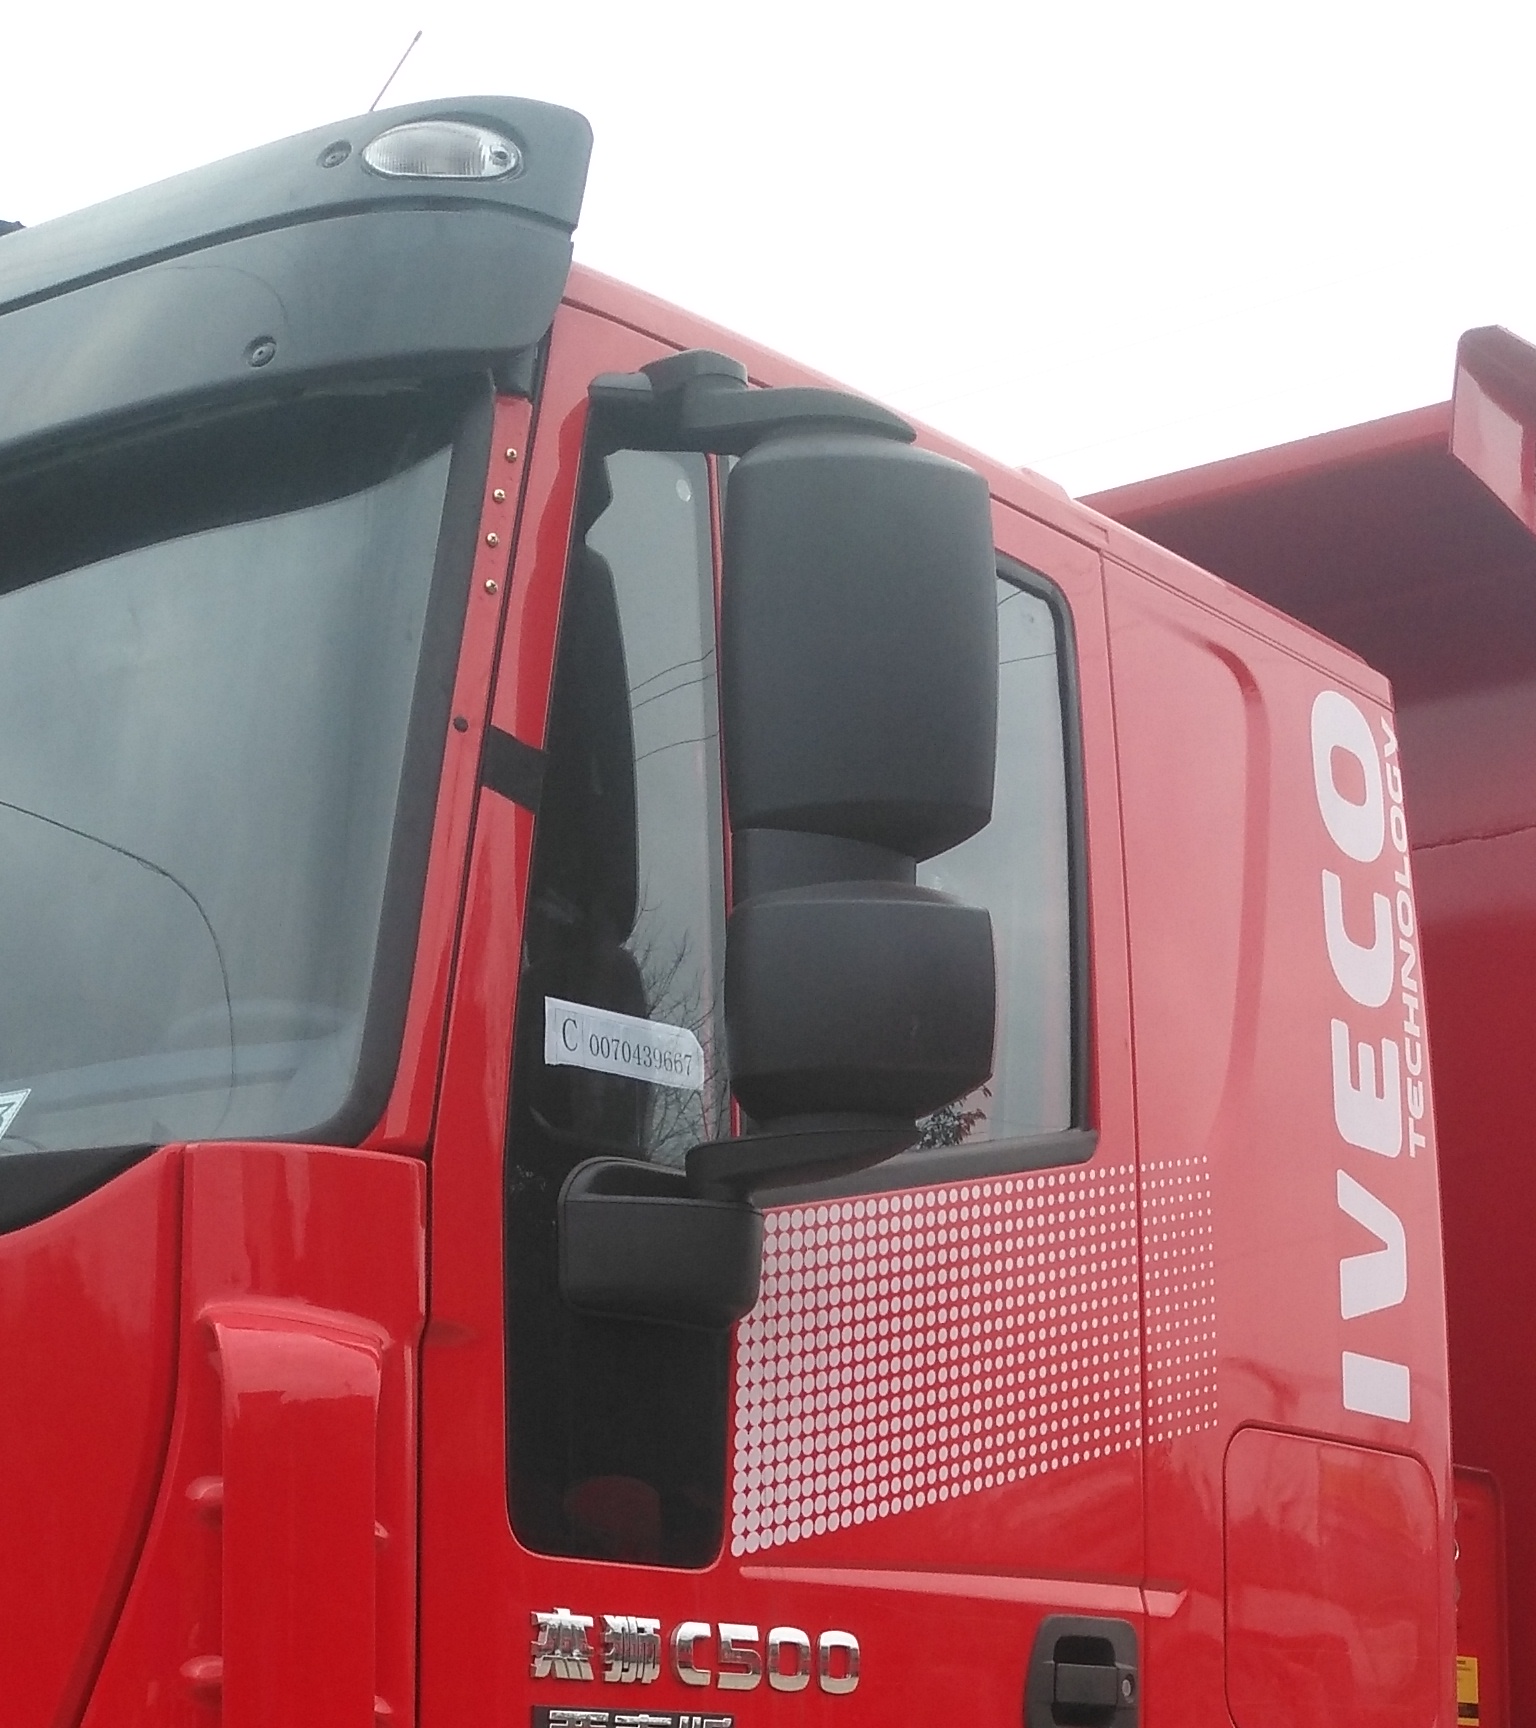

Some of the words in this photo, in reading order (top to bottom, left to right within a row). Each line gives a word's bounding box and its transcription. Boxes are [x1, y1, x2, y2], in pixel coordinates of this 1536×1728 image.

[562, 1018, 578, 1051] C
[589, 1033, 693, 1076] 0070439667
[1311, 690, 1411, 1423] IVECO
[1381, 716, 1426, 1159] TECHNOLOGY
